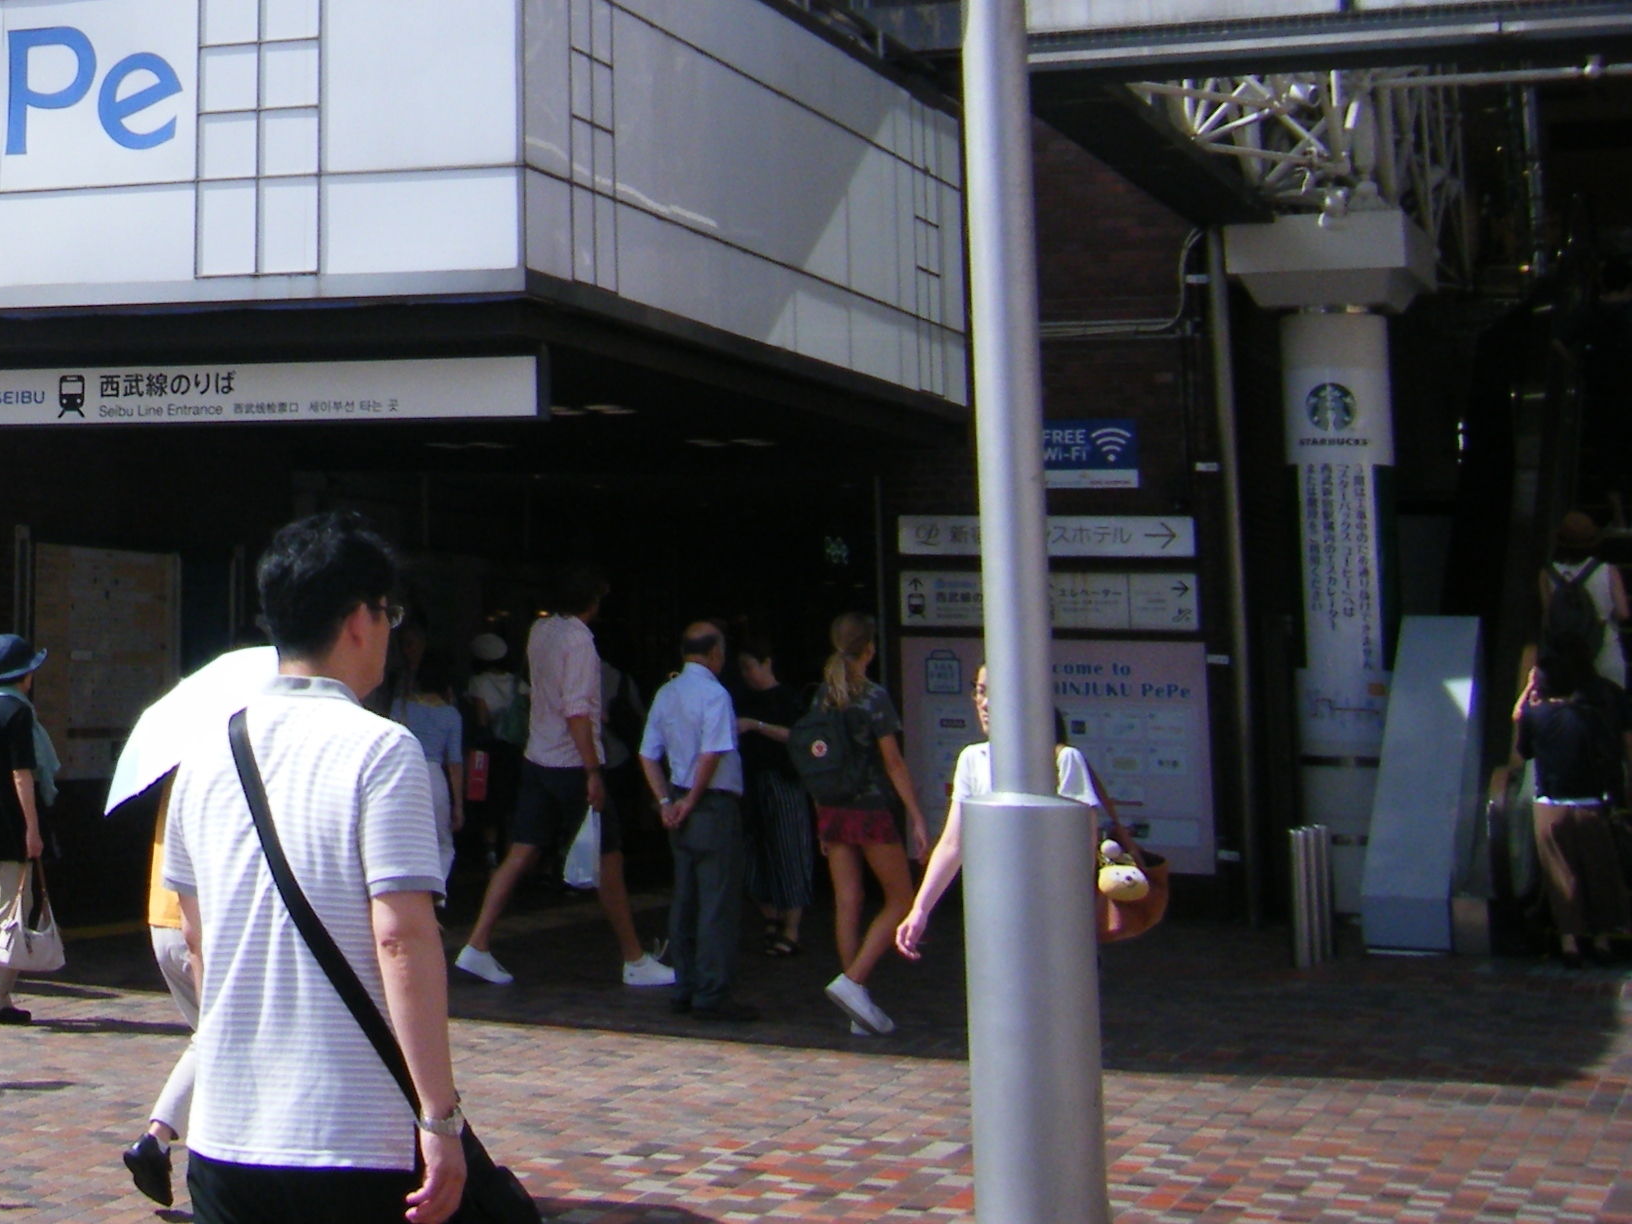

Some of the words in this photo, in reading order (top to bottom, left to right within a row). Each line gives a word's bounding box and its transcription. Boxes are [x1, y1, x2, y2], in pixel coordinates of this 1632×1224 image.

[99, 370, 237, 398] 西武線のりば
[99, 403, 134, 417] Seibu
[137, 403, 165, 417] Line
[167, 402, 223, 416] Entrance
[1052, 663, 1103, 676] come
[1112, 662, 1131, 676] to
[1053, 681, 1132, 697] INJUKU
[1140, 682, 1191, 698] PePe
